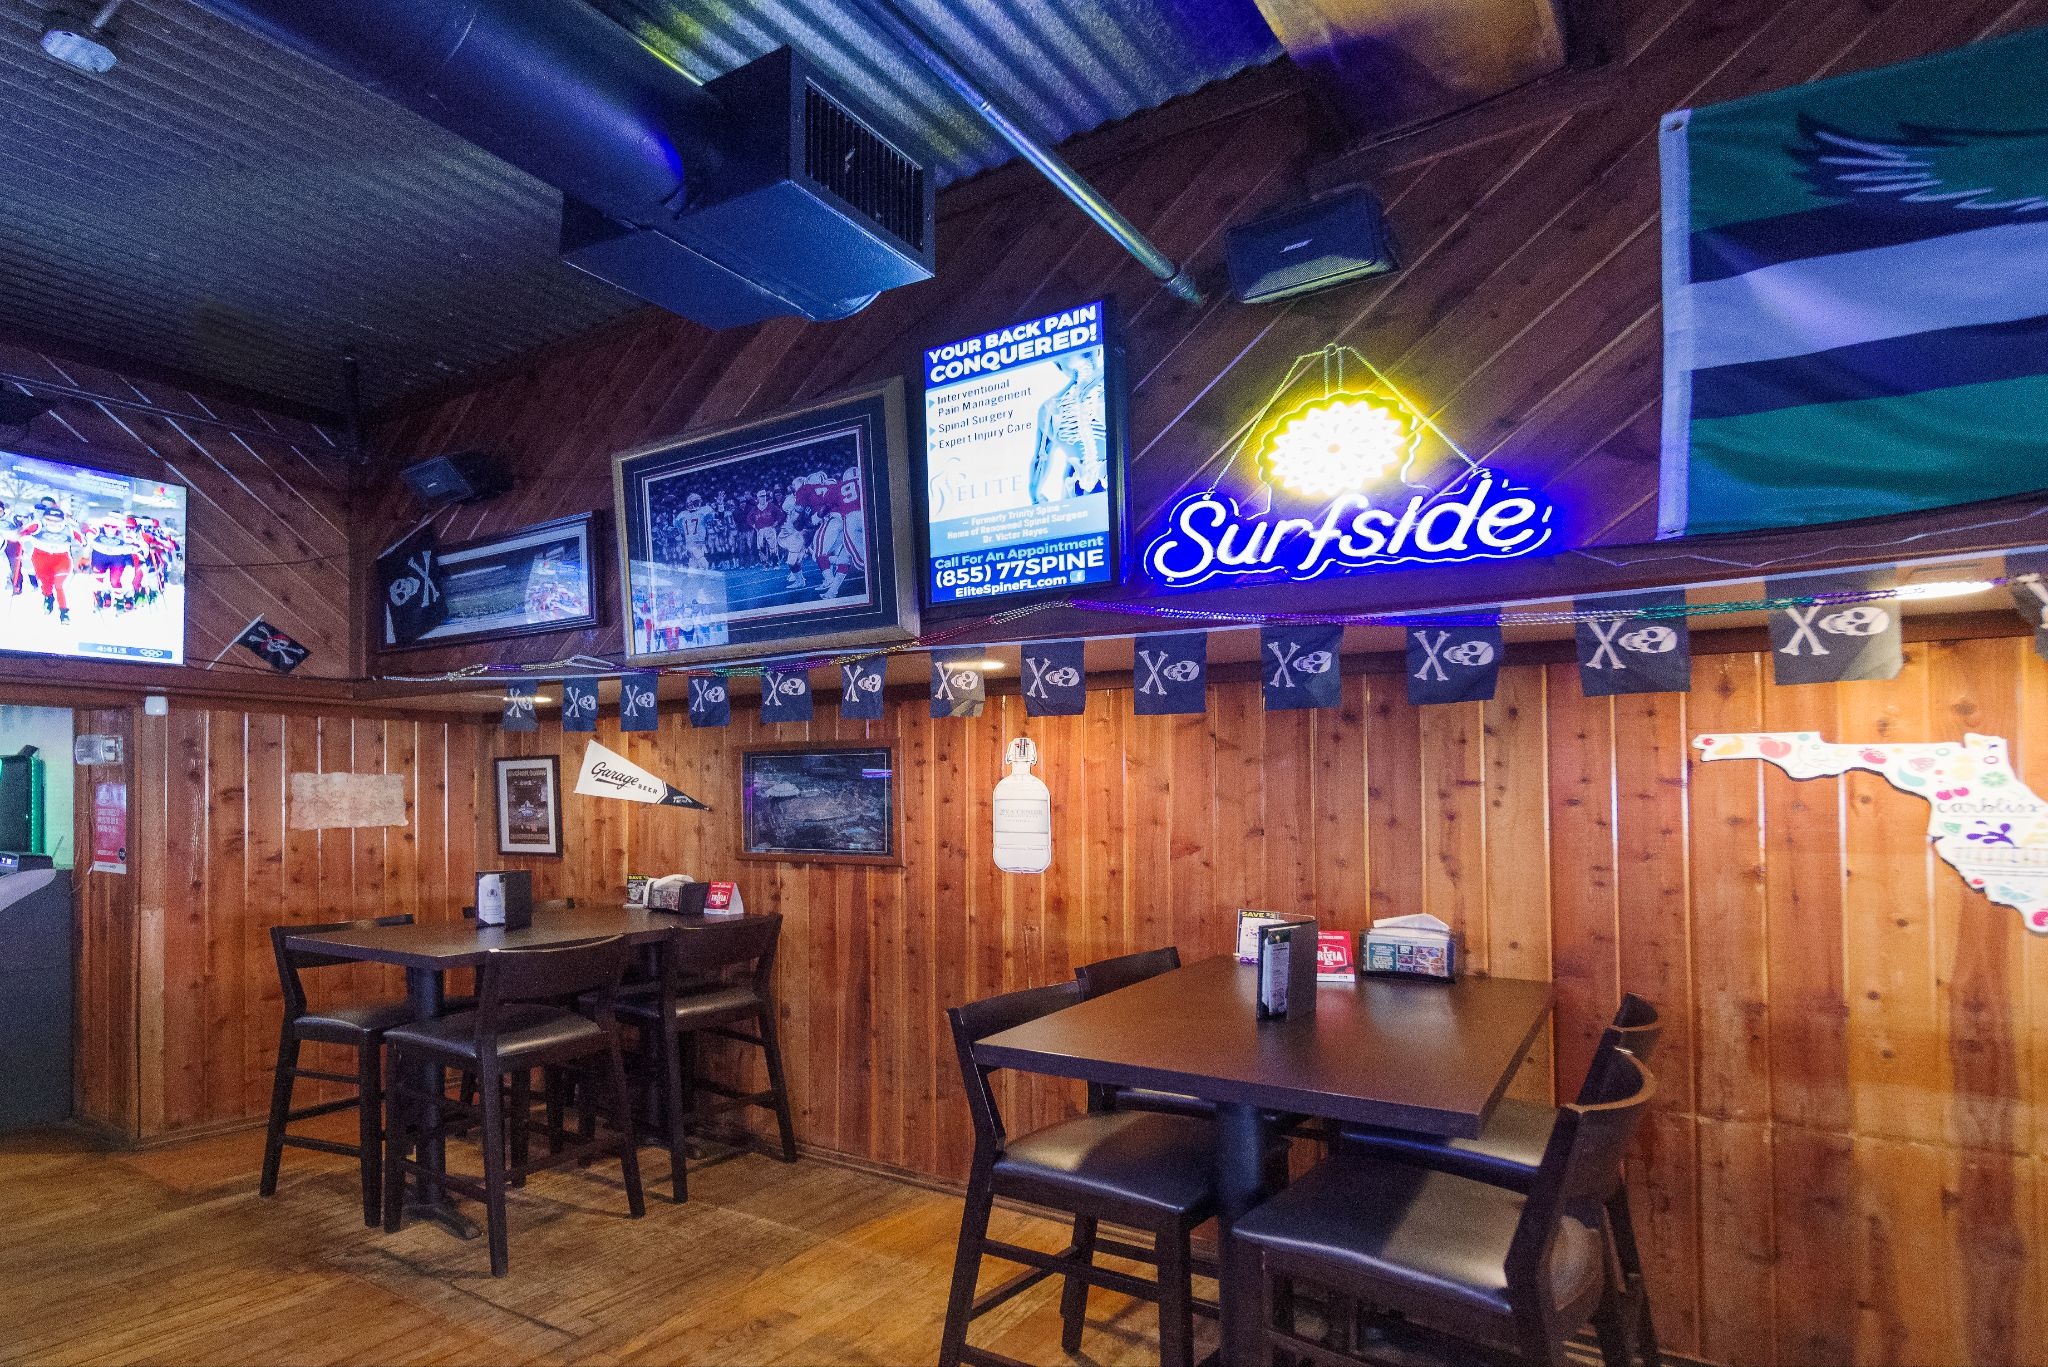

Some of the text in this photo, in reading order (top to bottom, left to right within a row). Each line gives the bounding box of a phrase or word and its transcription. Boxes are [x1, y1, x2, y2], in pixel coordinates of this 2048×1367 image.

[928, 305, 1097, 364] YOUR BACK PAIN
[930, 323, 1097, 383] CONQUERED!
[937, 379, 1010, 405] Interventional
[938, 387, 1032, 417] Pain Management
[938, 409, 1014, 434] Spinal Surgery
[939, 421, 1032, 449] Expert Injury Care
[957, 474, 1022, 502] ELITE
[970, 527, 979, 537] of
[1023, 516, 1050, 529] Spinal
[1051, 509, 1088, 522] Surgeon
[971, 513, 1007, 526] Formerly
[1008, 506, 1034, 520] Trinity
[1154, 478, 1536, 580] Surfside
[935, 536, 1104, 570] Call For An Appointment
[936, 549, 1105, 588] (855) 77SPINE
[955, 575, 1067, 598] EliteSpineFL.com
[591, 761, 658, 794] Garage BEER
